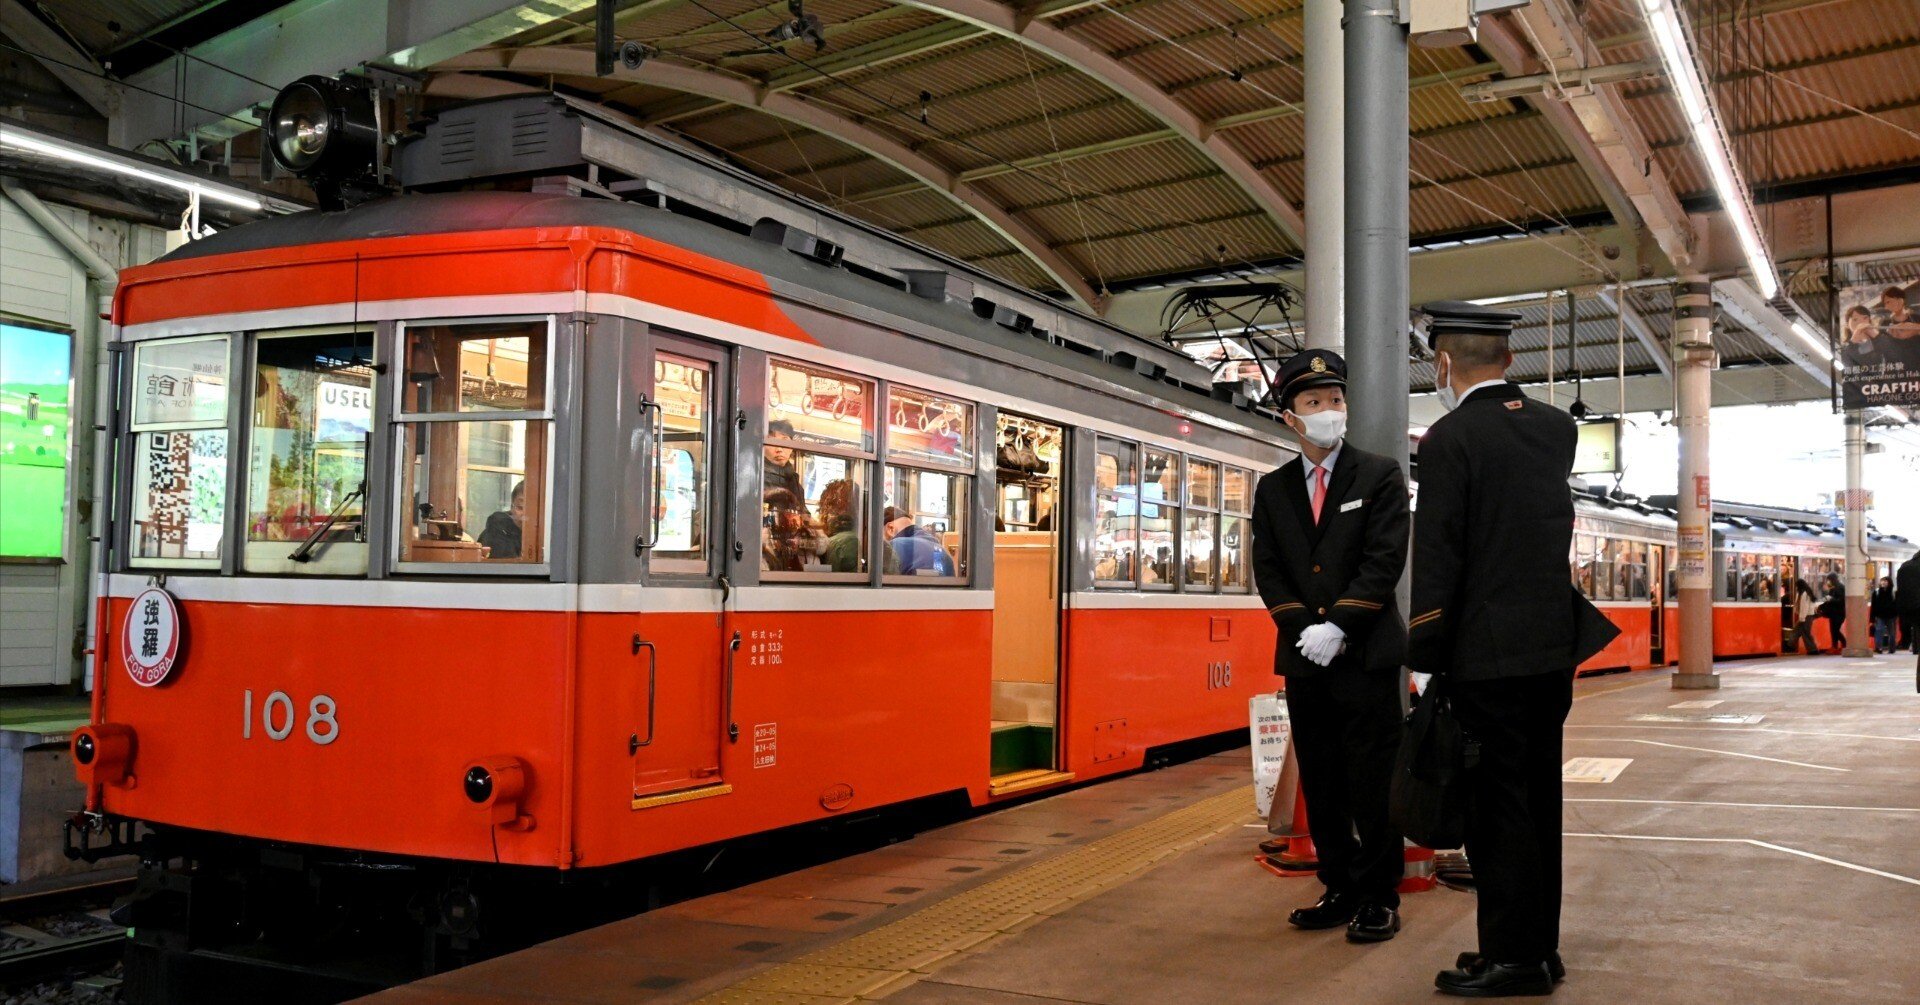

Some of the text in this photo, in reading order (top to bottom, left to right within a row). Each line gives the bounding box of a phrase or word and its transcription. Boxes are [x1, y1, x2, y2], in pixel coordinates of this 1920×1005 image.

[1861, 373, 1896, 382] experience
[1906, 369, 1920, 378] Hak
[1866, 393, 1903, 403] HAKONE
[141, 599, 160, 658] 強羅
[127, 656, 144, 680] FOR
[1208, 661, 1230, 690] 108
[243, 689, 339, 745] 108
